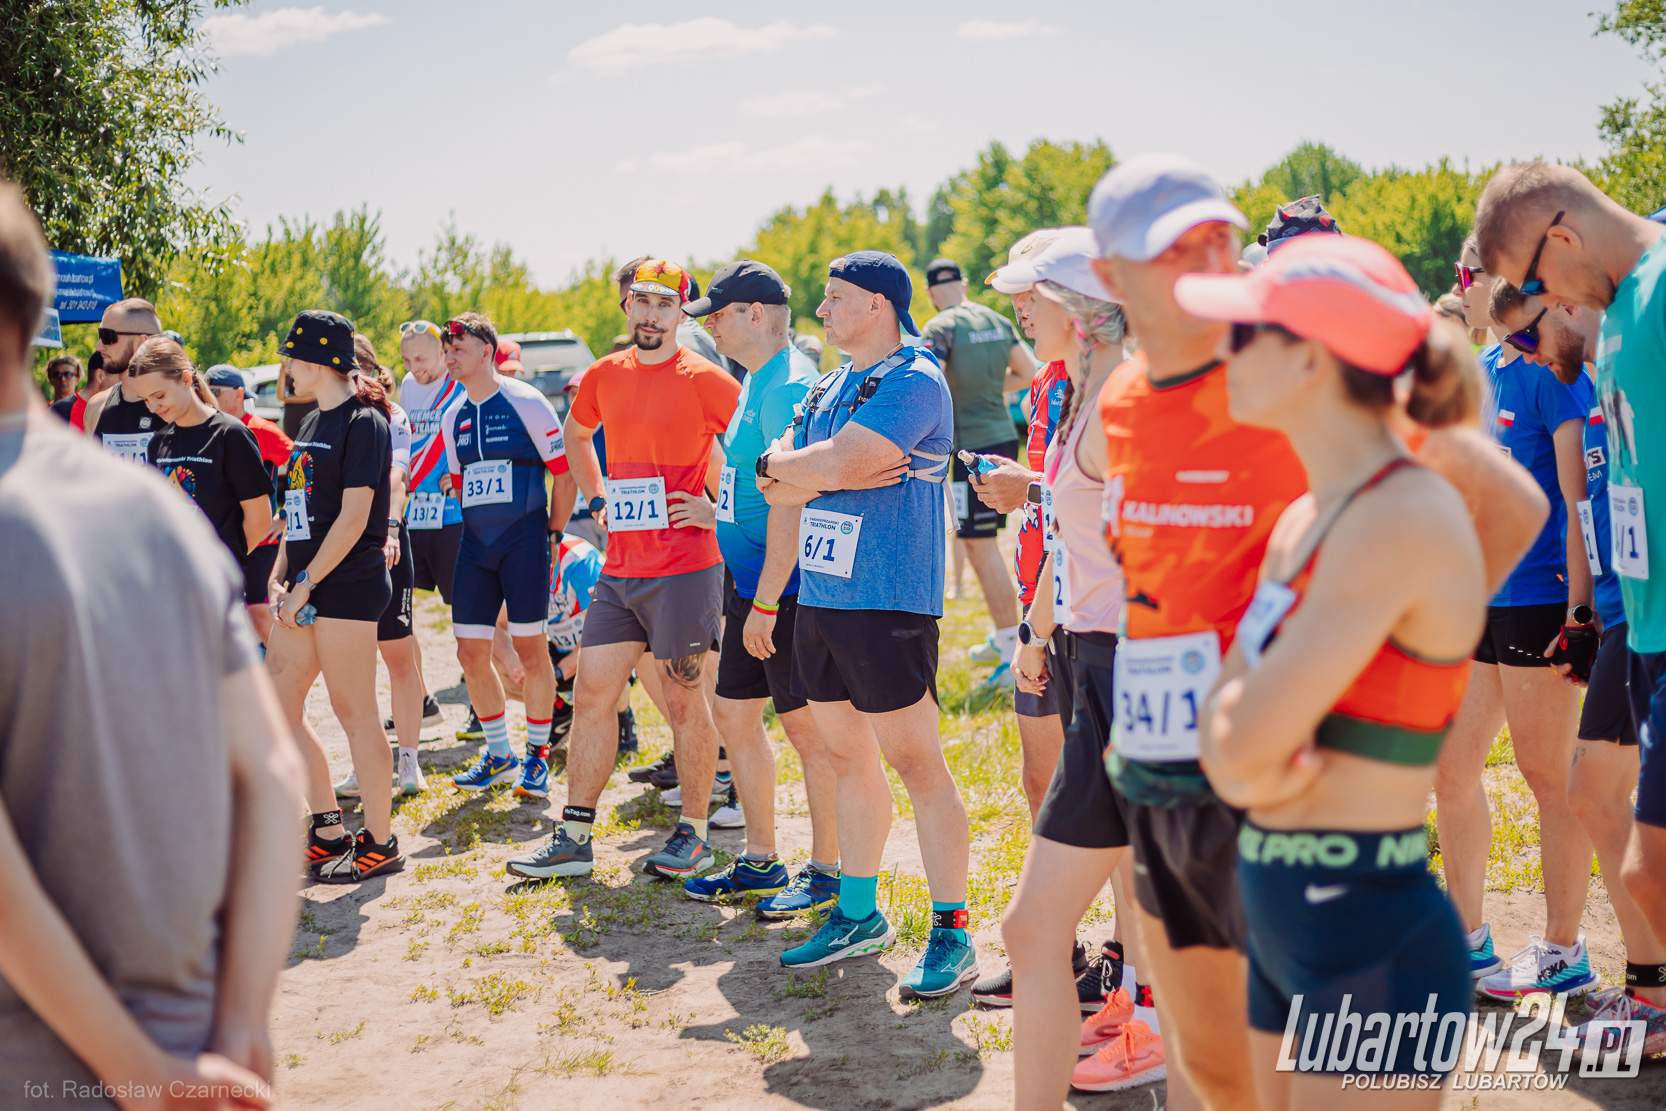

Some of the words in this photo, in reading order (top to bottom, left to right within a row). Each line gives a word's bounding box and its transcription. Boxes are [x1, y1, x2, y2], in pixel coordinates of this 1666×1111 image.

[467, 478, 504, 497] 33/1
[413, 507, 437, 520] 13/2
[615, 499, 659, 520] 12/1
[1123, 501, 1254, 528] KALINOWSKI
[810, 521, 836, 530] TRIATHLON
[804, 535, 835, 562] 6/1
[1123, 689, 1198, 736] 34/1
